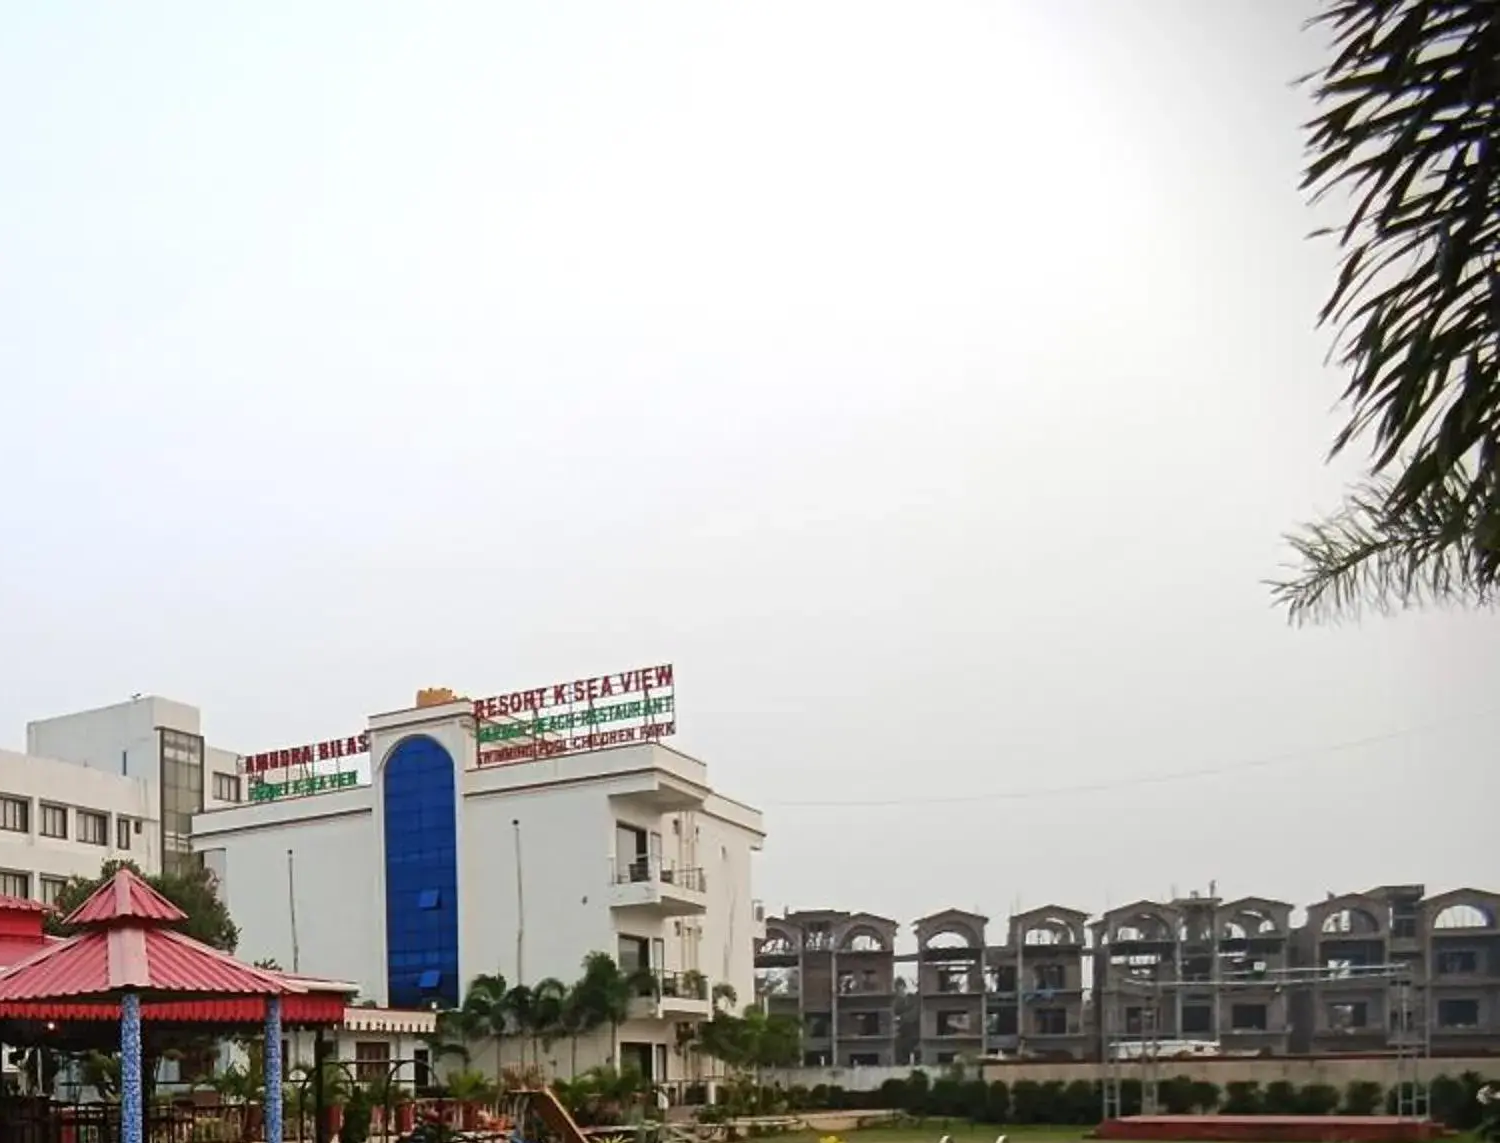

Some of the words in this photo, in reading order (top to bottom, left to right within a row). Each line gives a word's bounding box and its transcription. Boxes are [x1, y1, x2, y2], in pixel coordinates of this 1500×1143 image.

[474, 687, 546, 719] RESORT
[553, 684, 567, 706] K
[574, 676, 612, 701] SEA
[619, 664, 673, 692] VIEW
